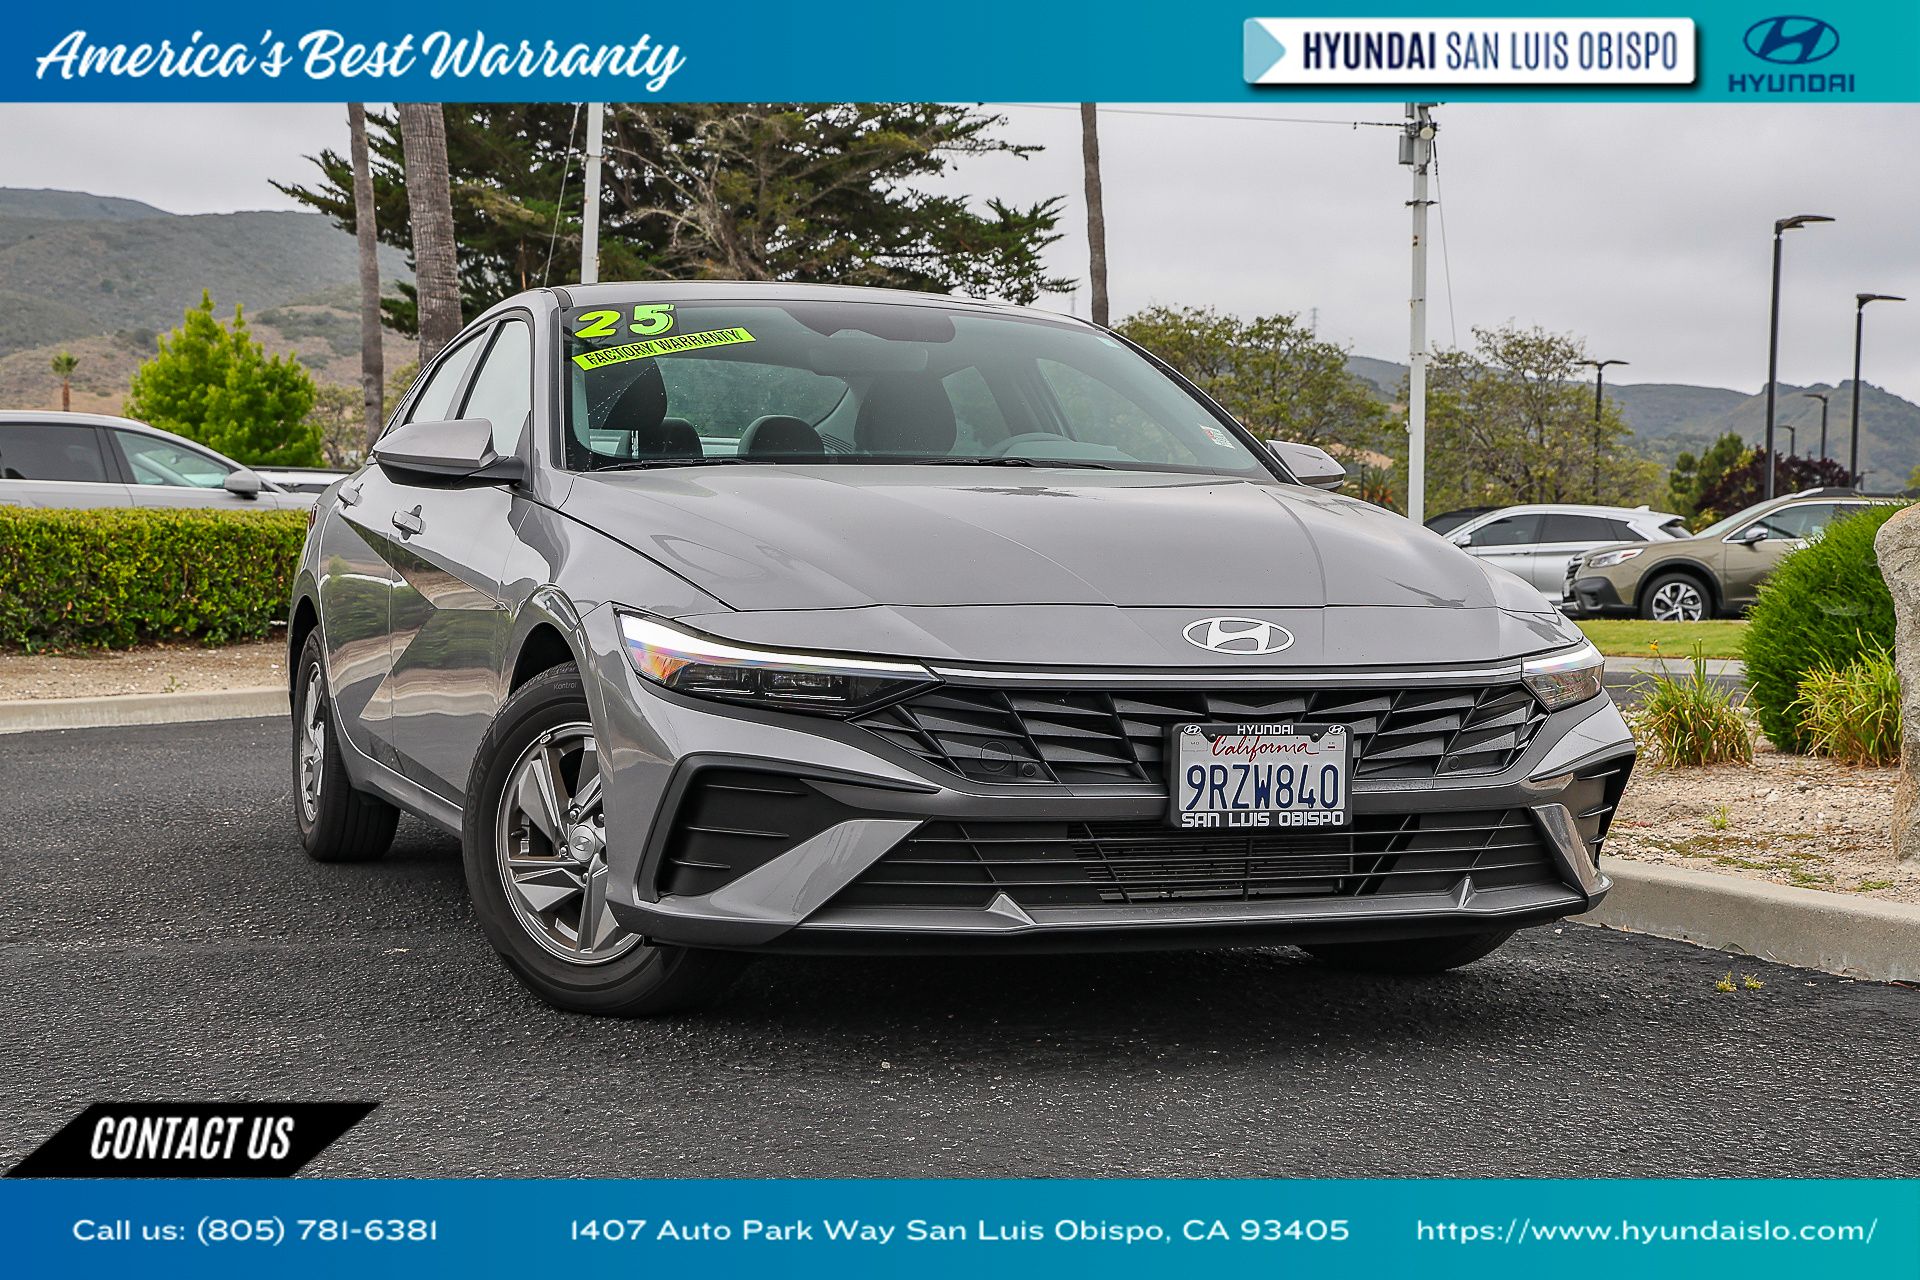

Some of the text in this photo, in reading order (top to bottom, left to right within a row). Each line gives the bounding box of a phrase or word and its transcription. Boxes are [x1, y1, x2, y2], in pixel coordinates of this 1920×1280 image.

[583, 329, 741, 365] FACTORY WARRANTY
[1237, 724, 1294, 735] HYUNDAI
[1212, 735, 1319, 762] California
[1186, 764, 1339, 810] 9RZW840
[1182, 811, 1344, 828] SAN LUIS OBISPO
